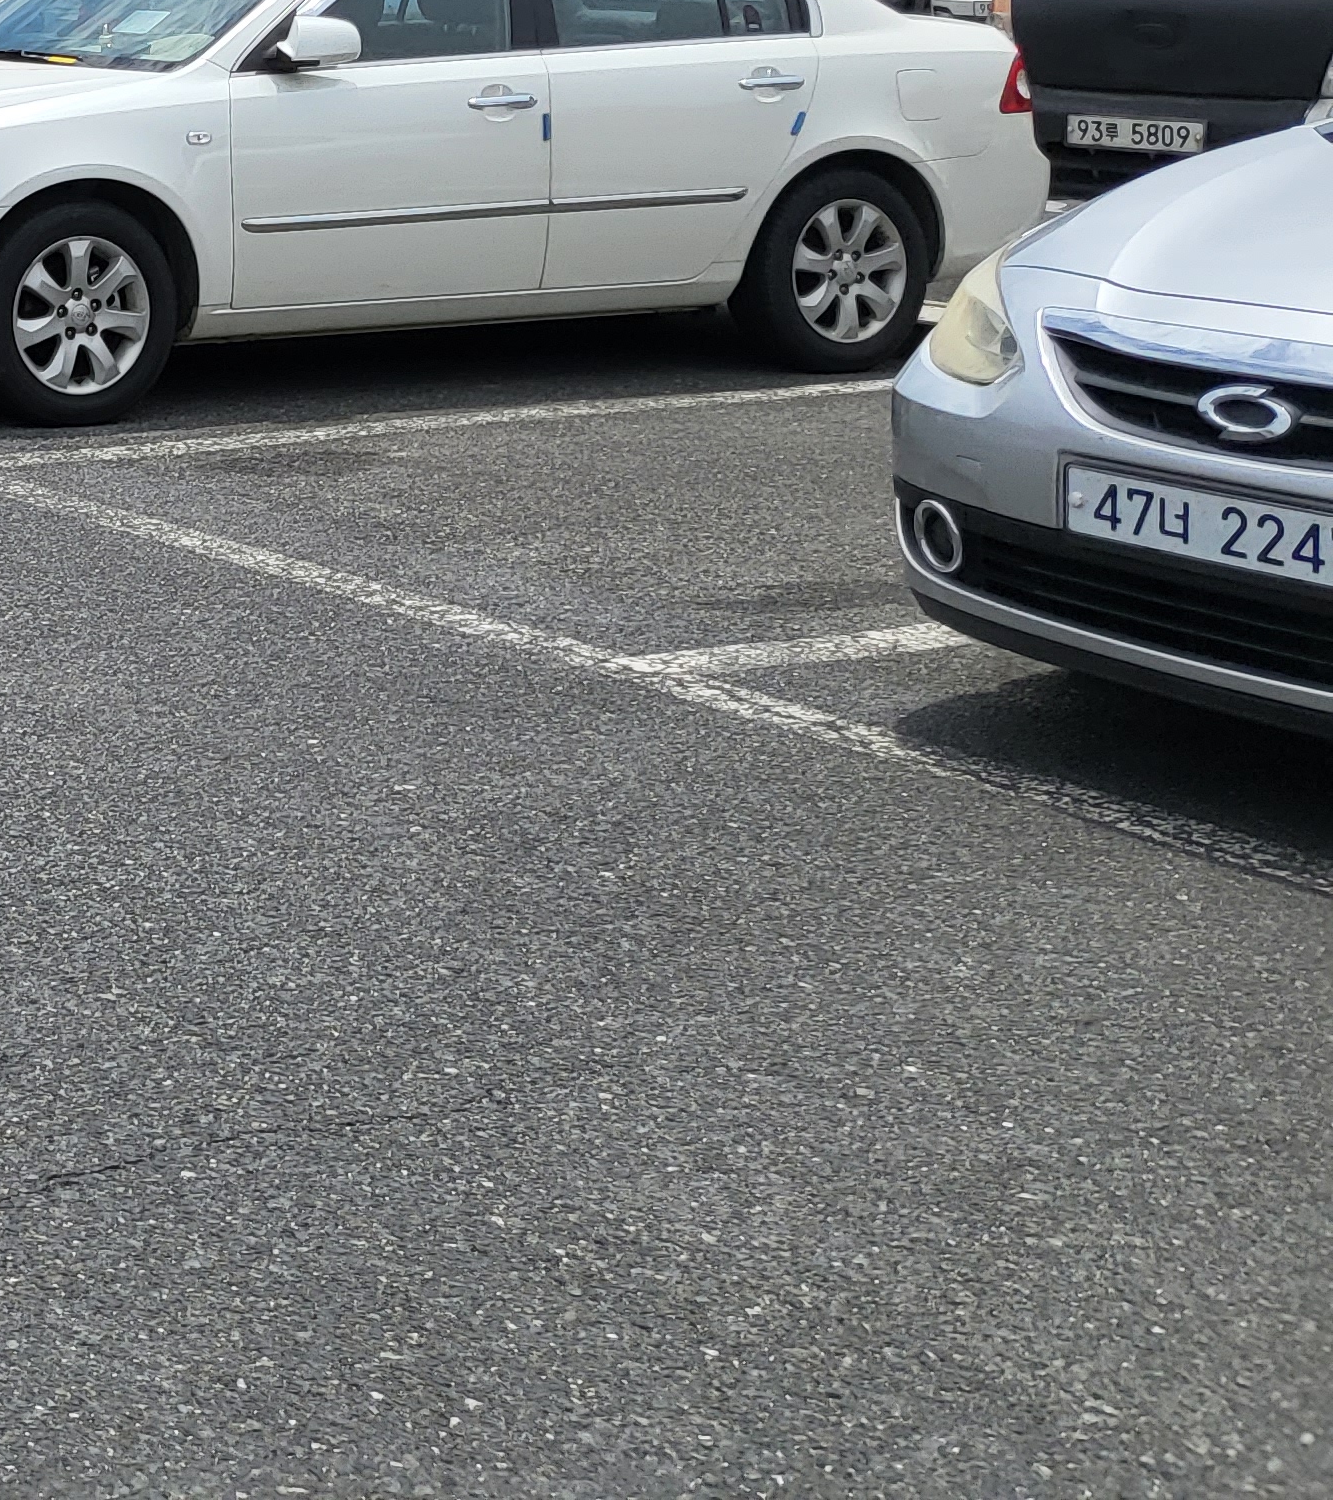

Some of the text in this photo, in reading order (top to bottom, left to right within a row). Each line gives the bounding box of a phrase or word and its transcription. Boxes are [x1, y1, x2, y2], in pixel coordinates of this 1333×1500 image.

[1077, 120, 1191, 148] 93루 5809
[1094, 482, 1333, 574] 47너 224
